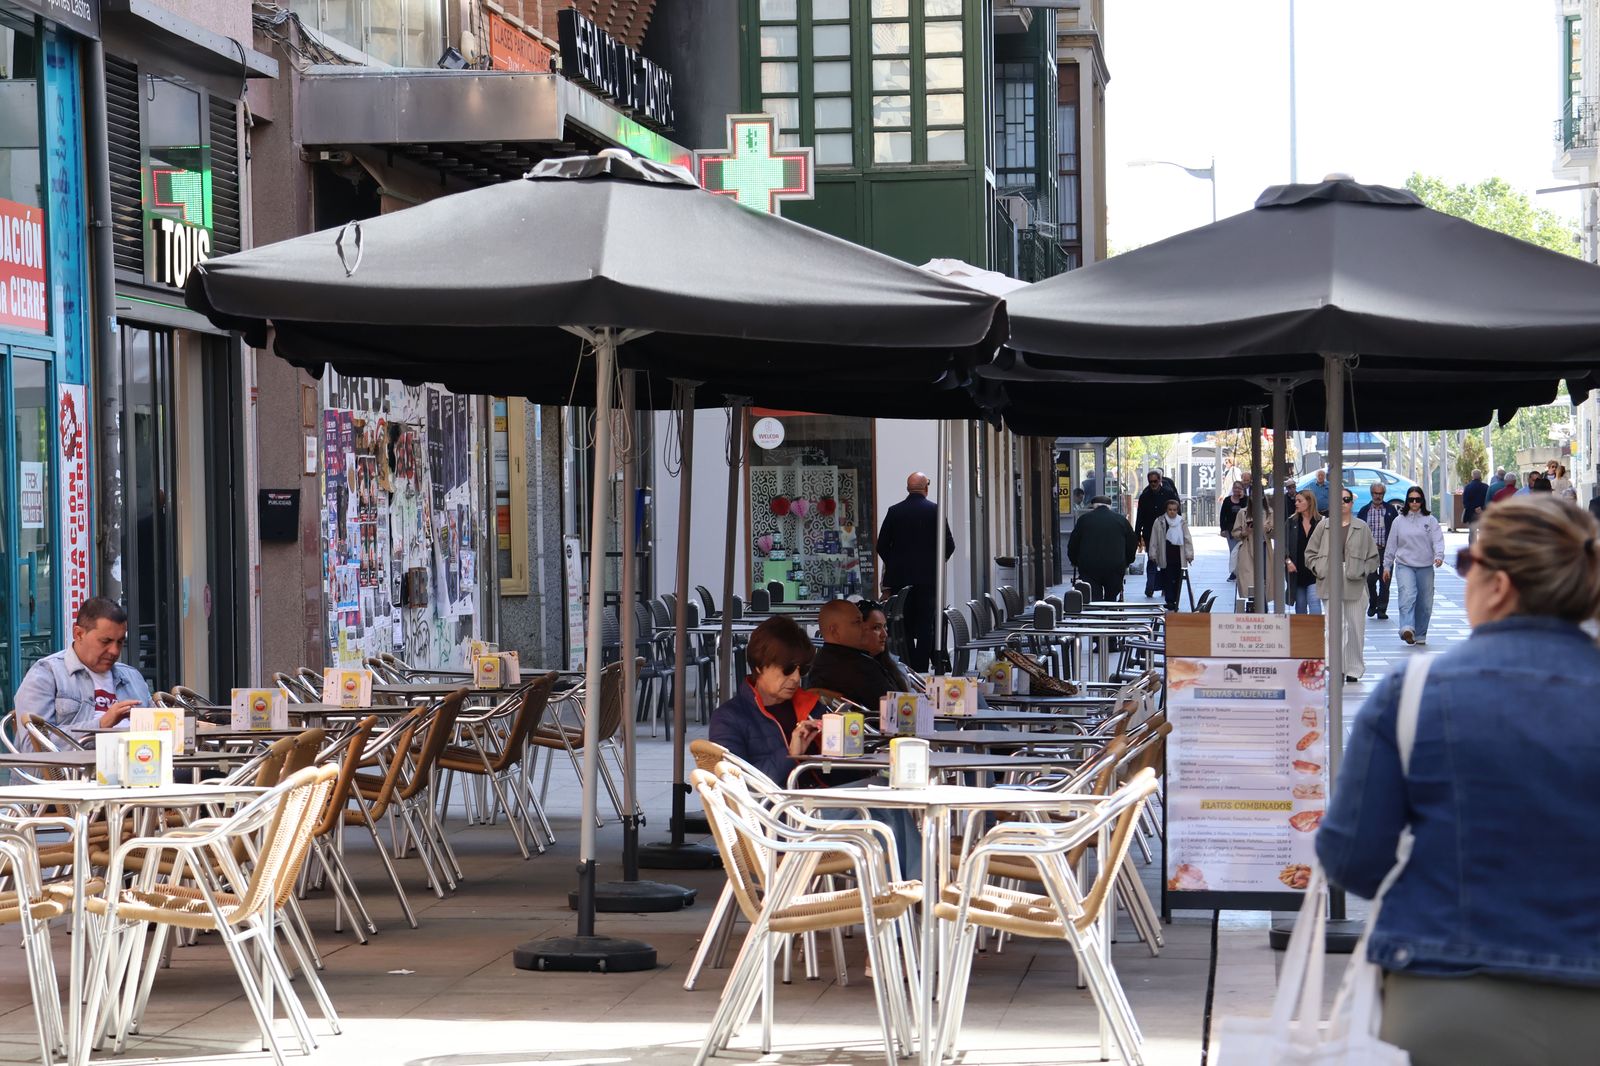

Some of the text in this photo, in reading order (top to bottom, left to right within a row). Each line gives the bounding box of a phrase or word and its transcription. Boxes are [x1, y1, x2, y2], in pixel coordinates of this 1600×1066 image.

[71, 0, 91, 21] Lastra
[494, 21, 513, 52] CLASES
[161, 217, 210, 288] TOUS
[10, 275, 46, 321] CIERRE
[328, 362, 391, 413] LIBRE DE
[75, 421, 85, 603] POR CIERRE
[1242, 666, 1277, 675] CAFETERÍA
[1201, 689, 1279, 698] TOSTAS CALIENTES
[1201, 801, 1292, 810] PLATOS COMBINADOS
